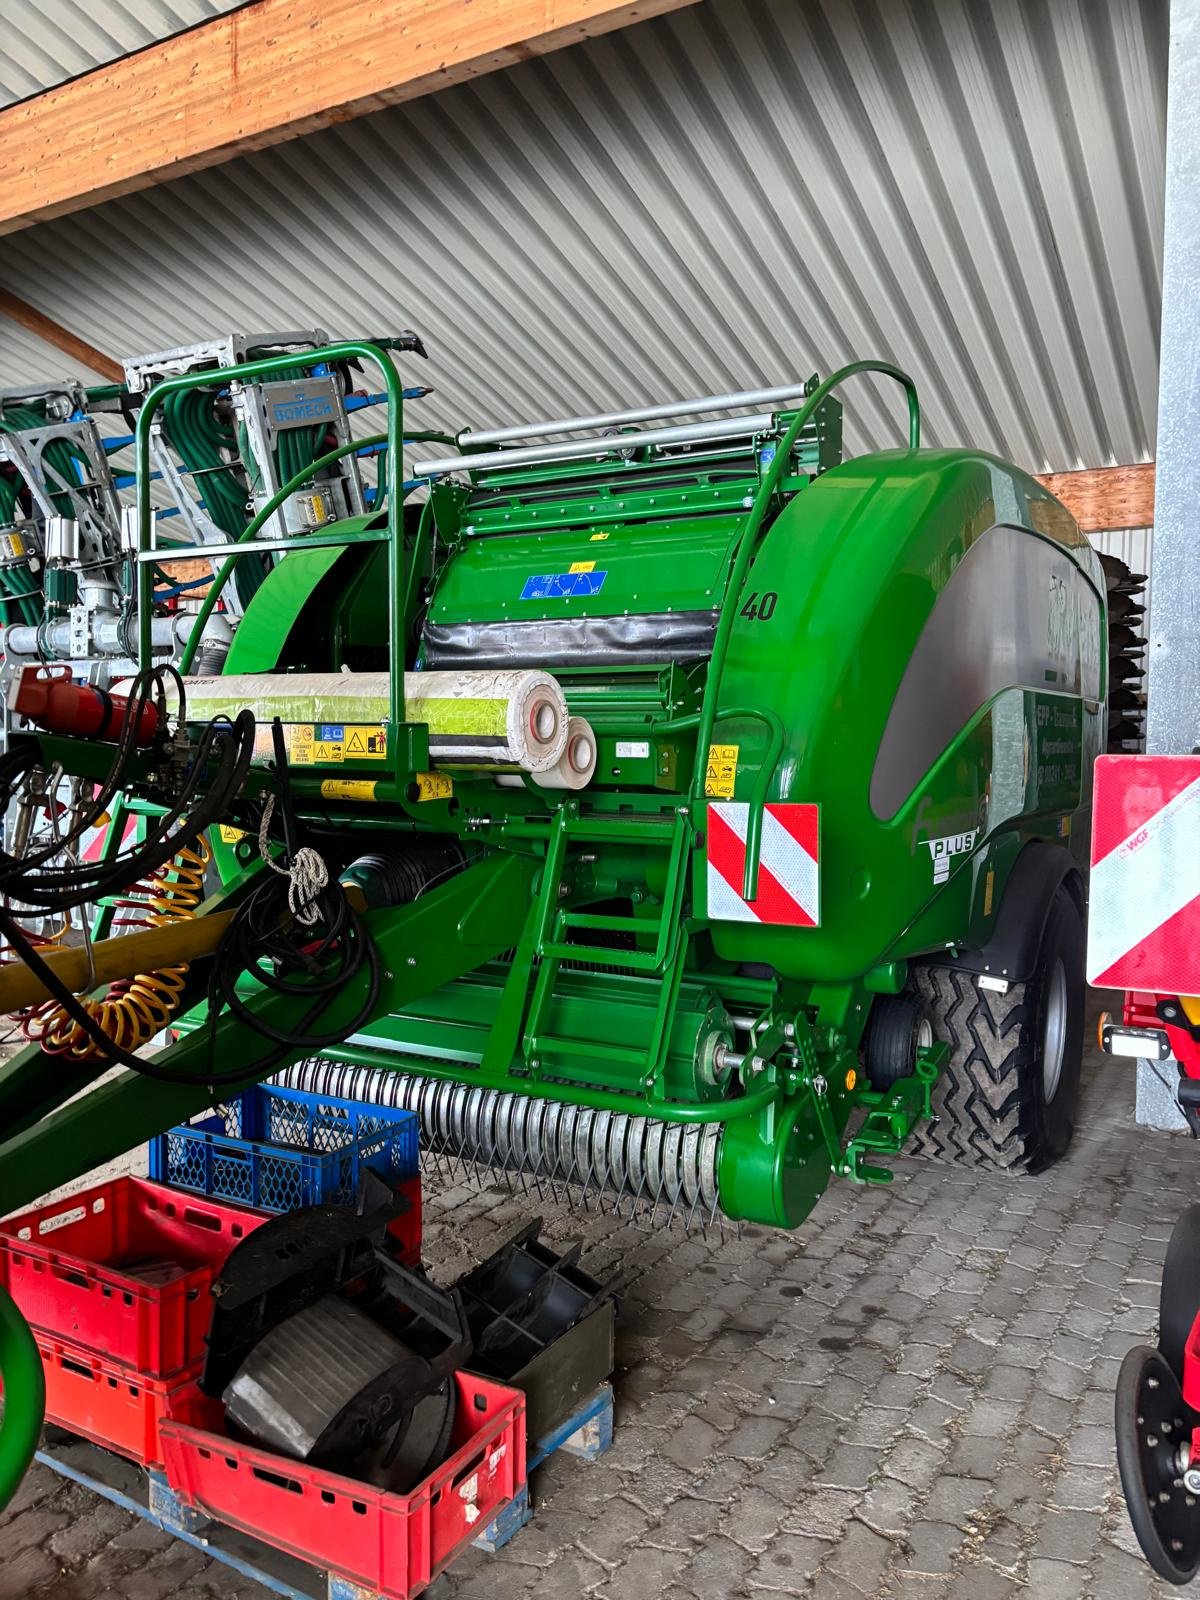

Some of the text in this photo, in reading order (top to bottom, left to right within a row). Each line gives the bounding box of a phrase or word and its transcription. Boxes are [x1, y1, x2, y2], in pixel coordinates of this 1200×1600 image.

[274, 403, 333, 423] BOMECH
[740, 592, 778, 621] 40
[934, 834, 972, 859] PLUS
